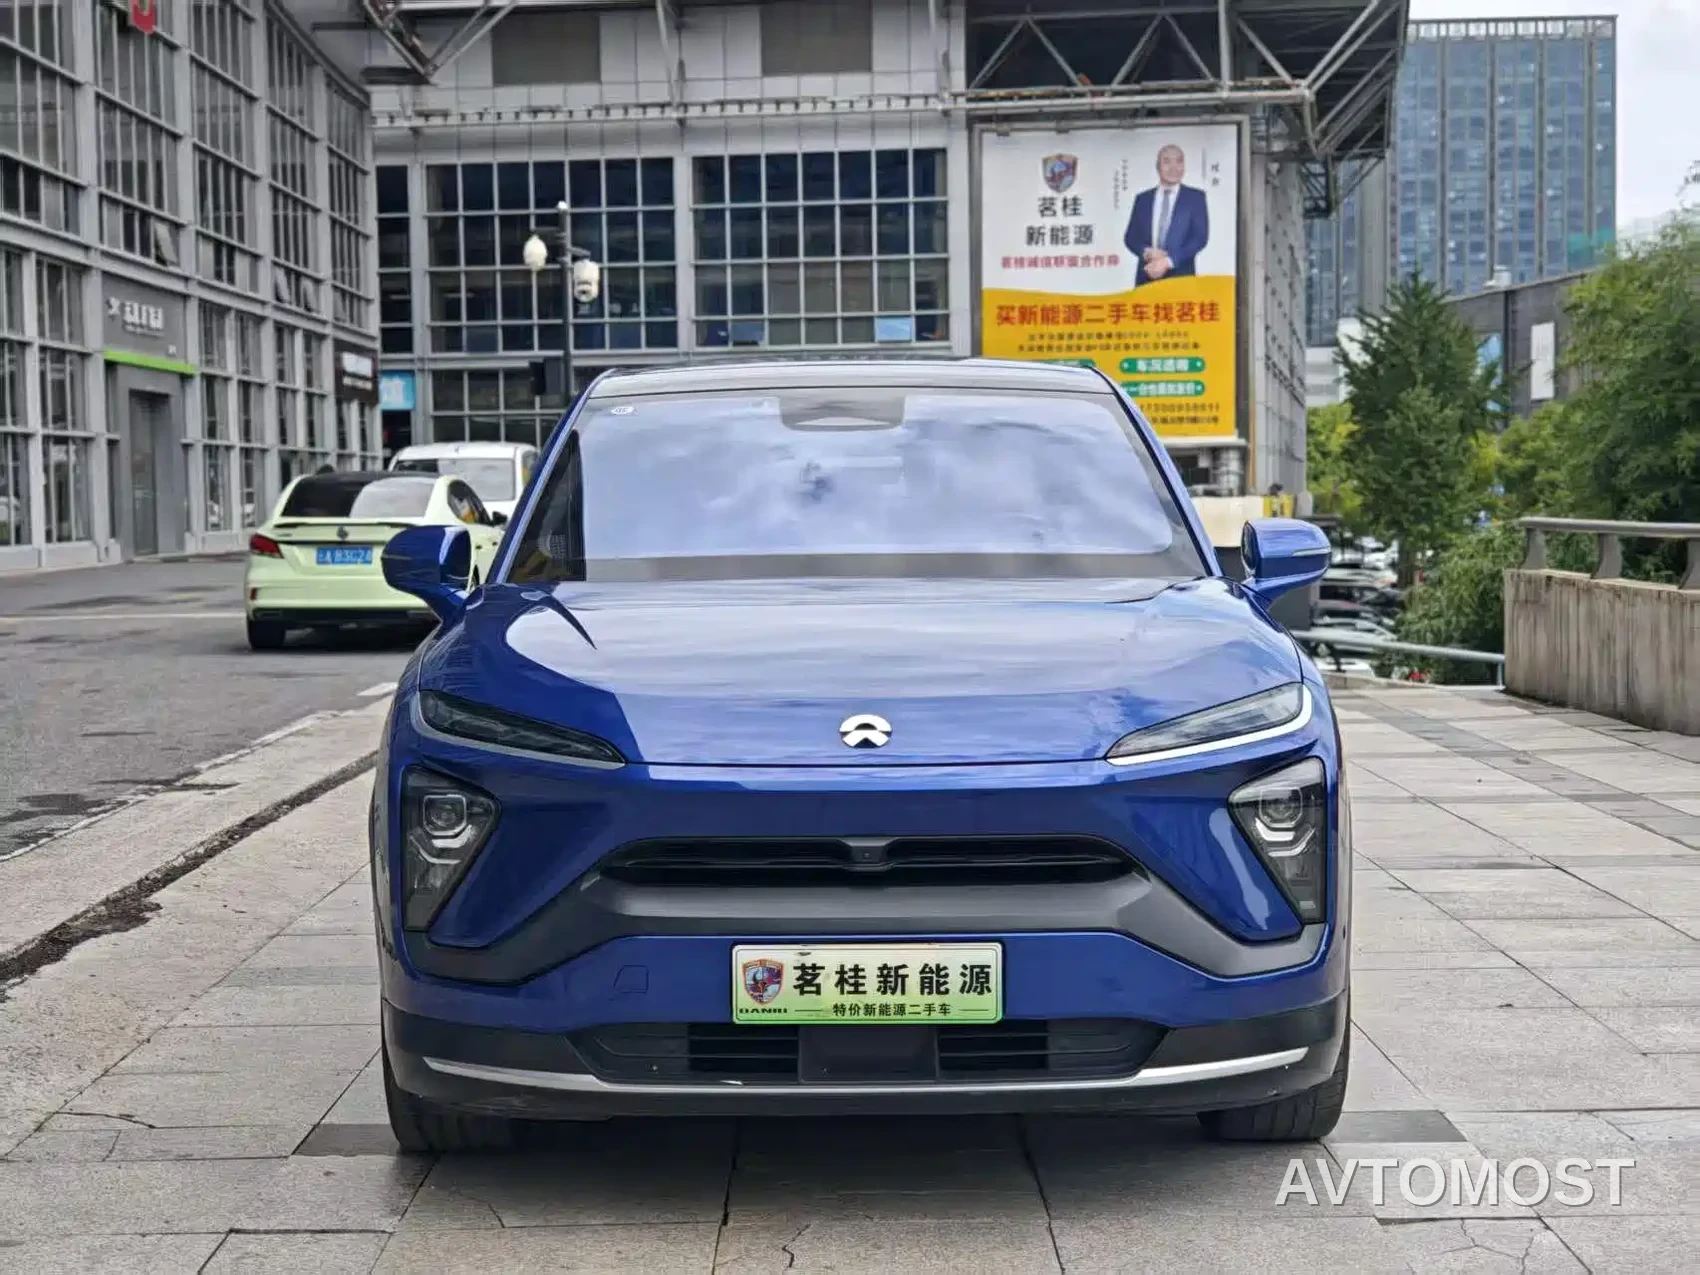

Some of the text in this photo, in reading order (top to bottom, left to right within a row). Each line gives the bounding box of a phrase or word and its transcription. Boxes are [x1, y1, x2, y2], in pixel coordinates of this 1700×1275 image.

[1037, 195, 1083, 218] 茗桂
[1026, 224, 1094, 246] 新能源
[996, 301, 1220, 326] 买新能源二手车找茗桂
[793, 963, 992, 997] 茗桂新能源
[833, 1002, 951, 1017] 特价新能源二手车
